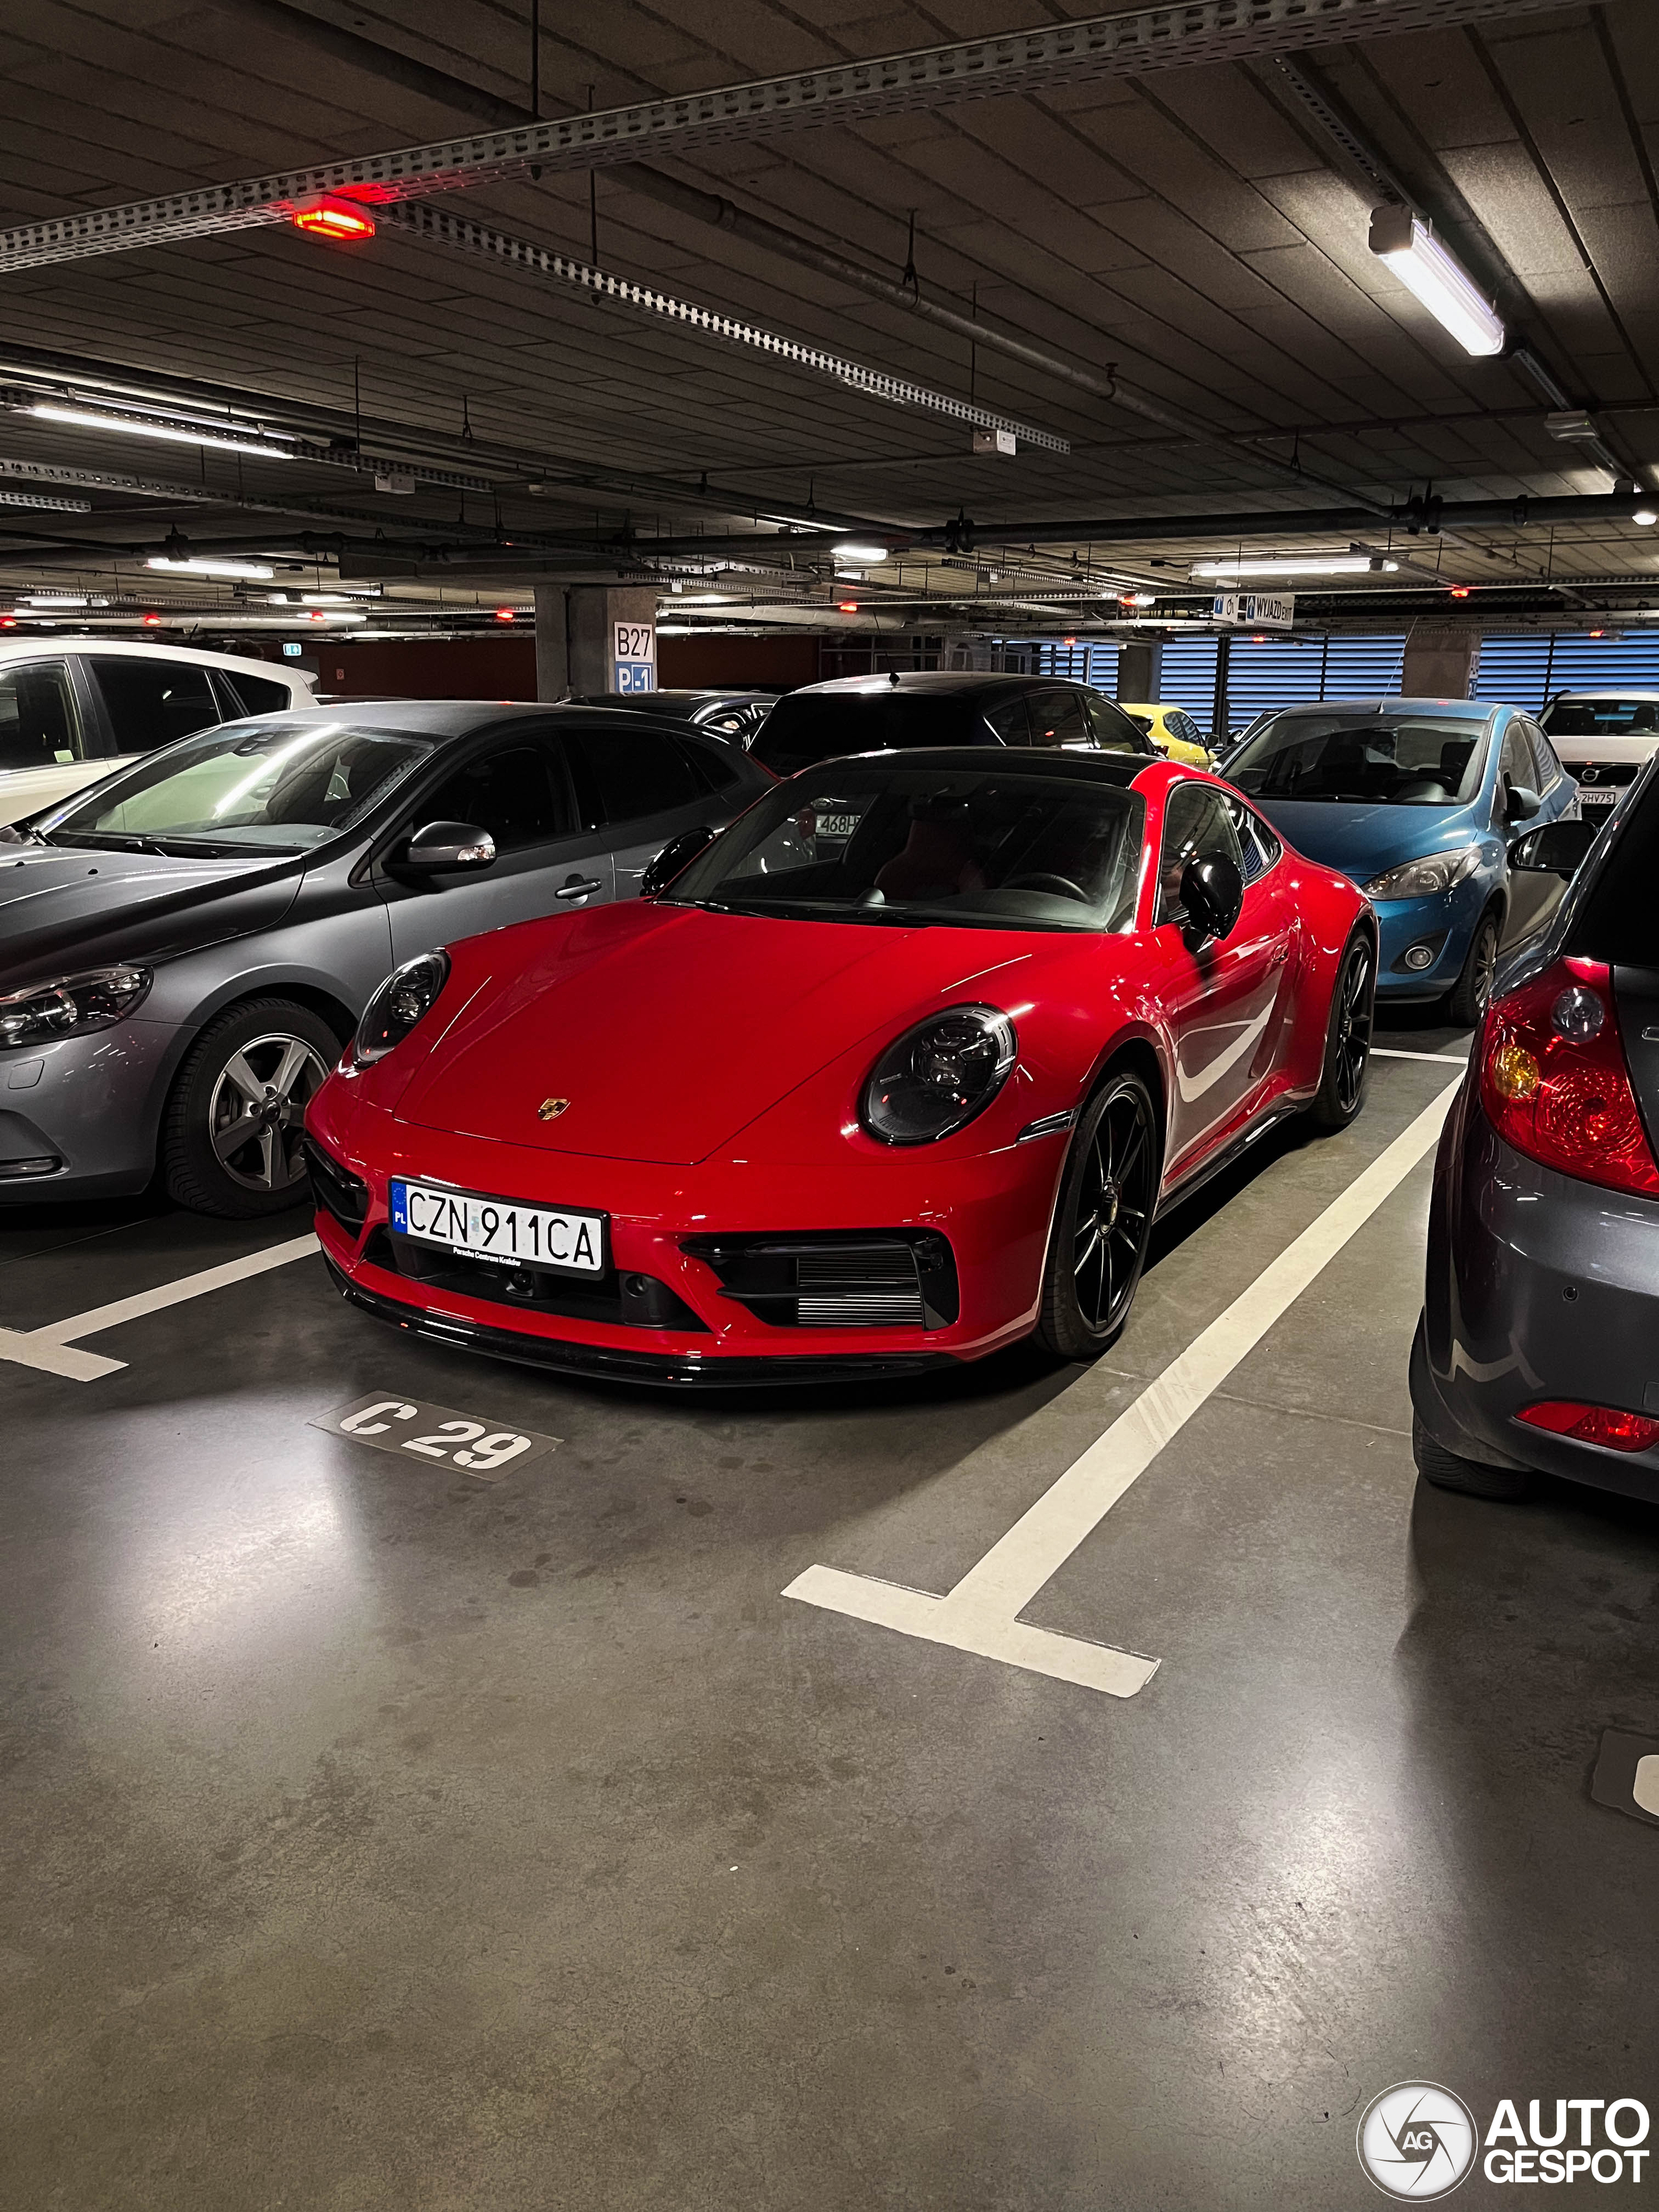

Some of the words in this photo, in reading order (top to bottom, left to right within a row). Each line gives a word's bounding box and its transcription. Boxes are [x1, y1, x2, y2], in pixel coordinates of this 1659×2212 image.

[1257, 597, 1281, 620] WYJAZD
[618, 627, 650, 657] B27
[395, 1211, 406, 1224] PL
[409, 1191, 468, 1242] CZN
[481, 1207, 594, 1265] 911CA
[453, 1246, 474, 1258] Porsche
[474, 1251, 499, 1263] Centrum
[340, 1401, 419, 1435] C
[400, 1420, 532, 1469] 29
